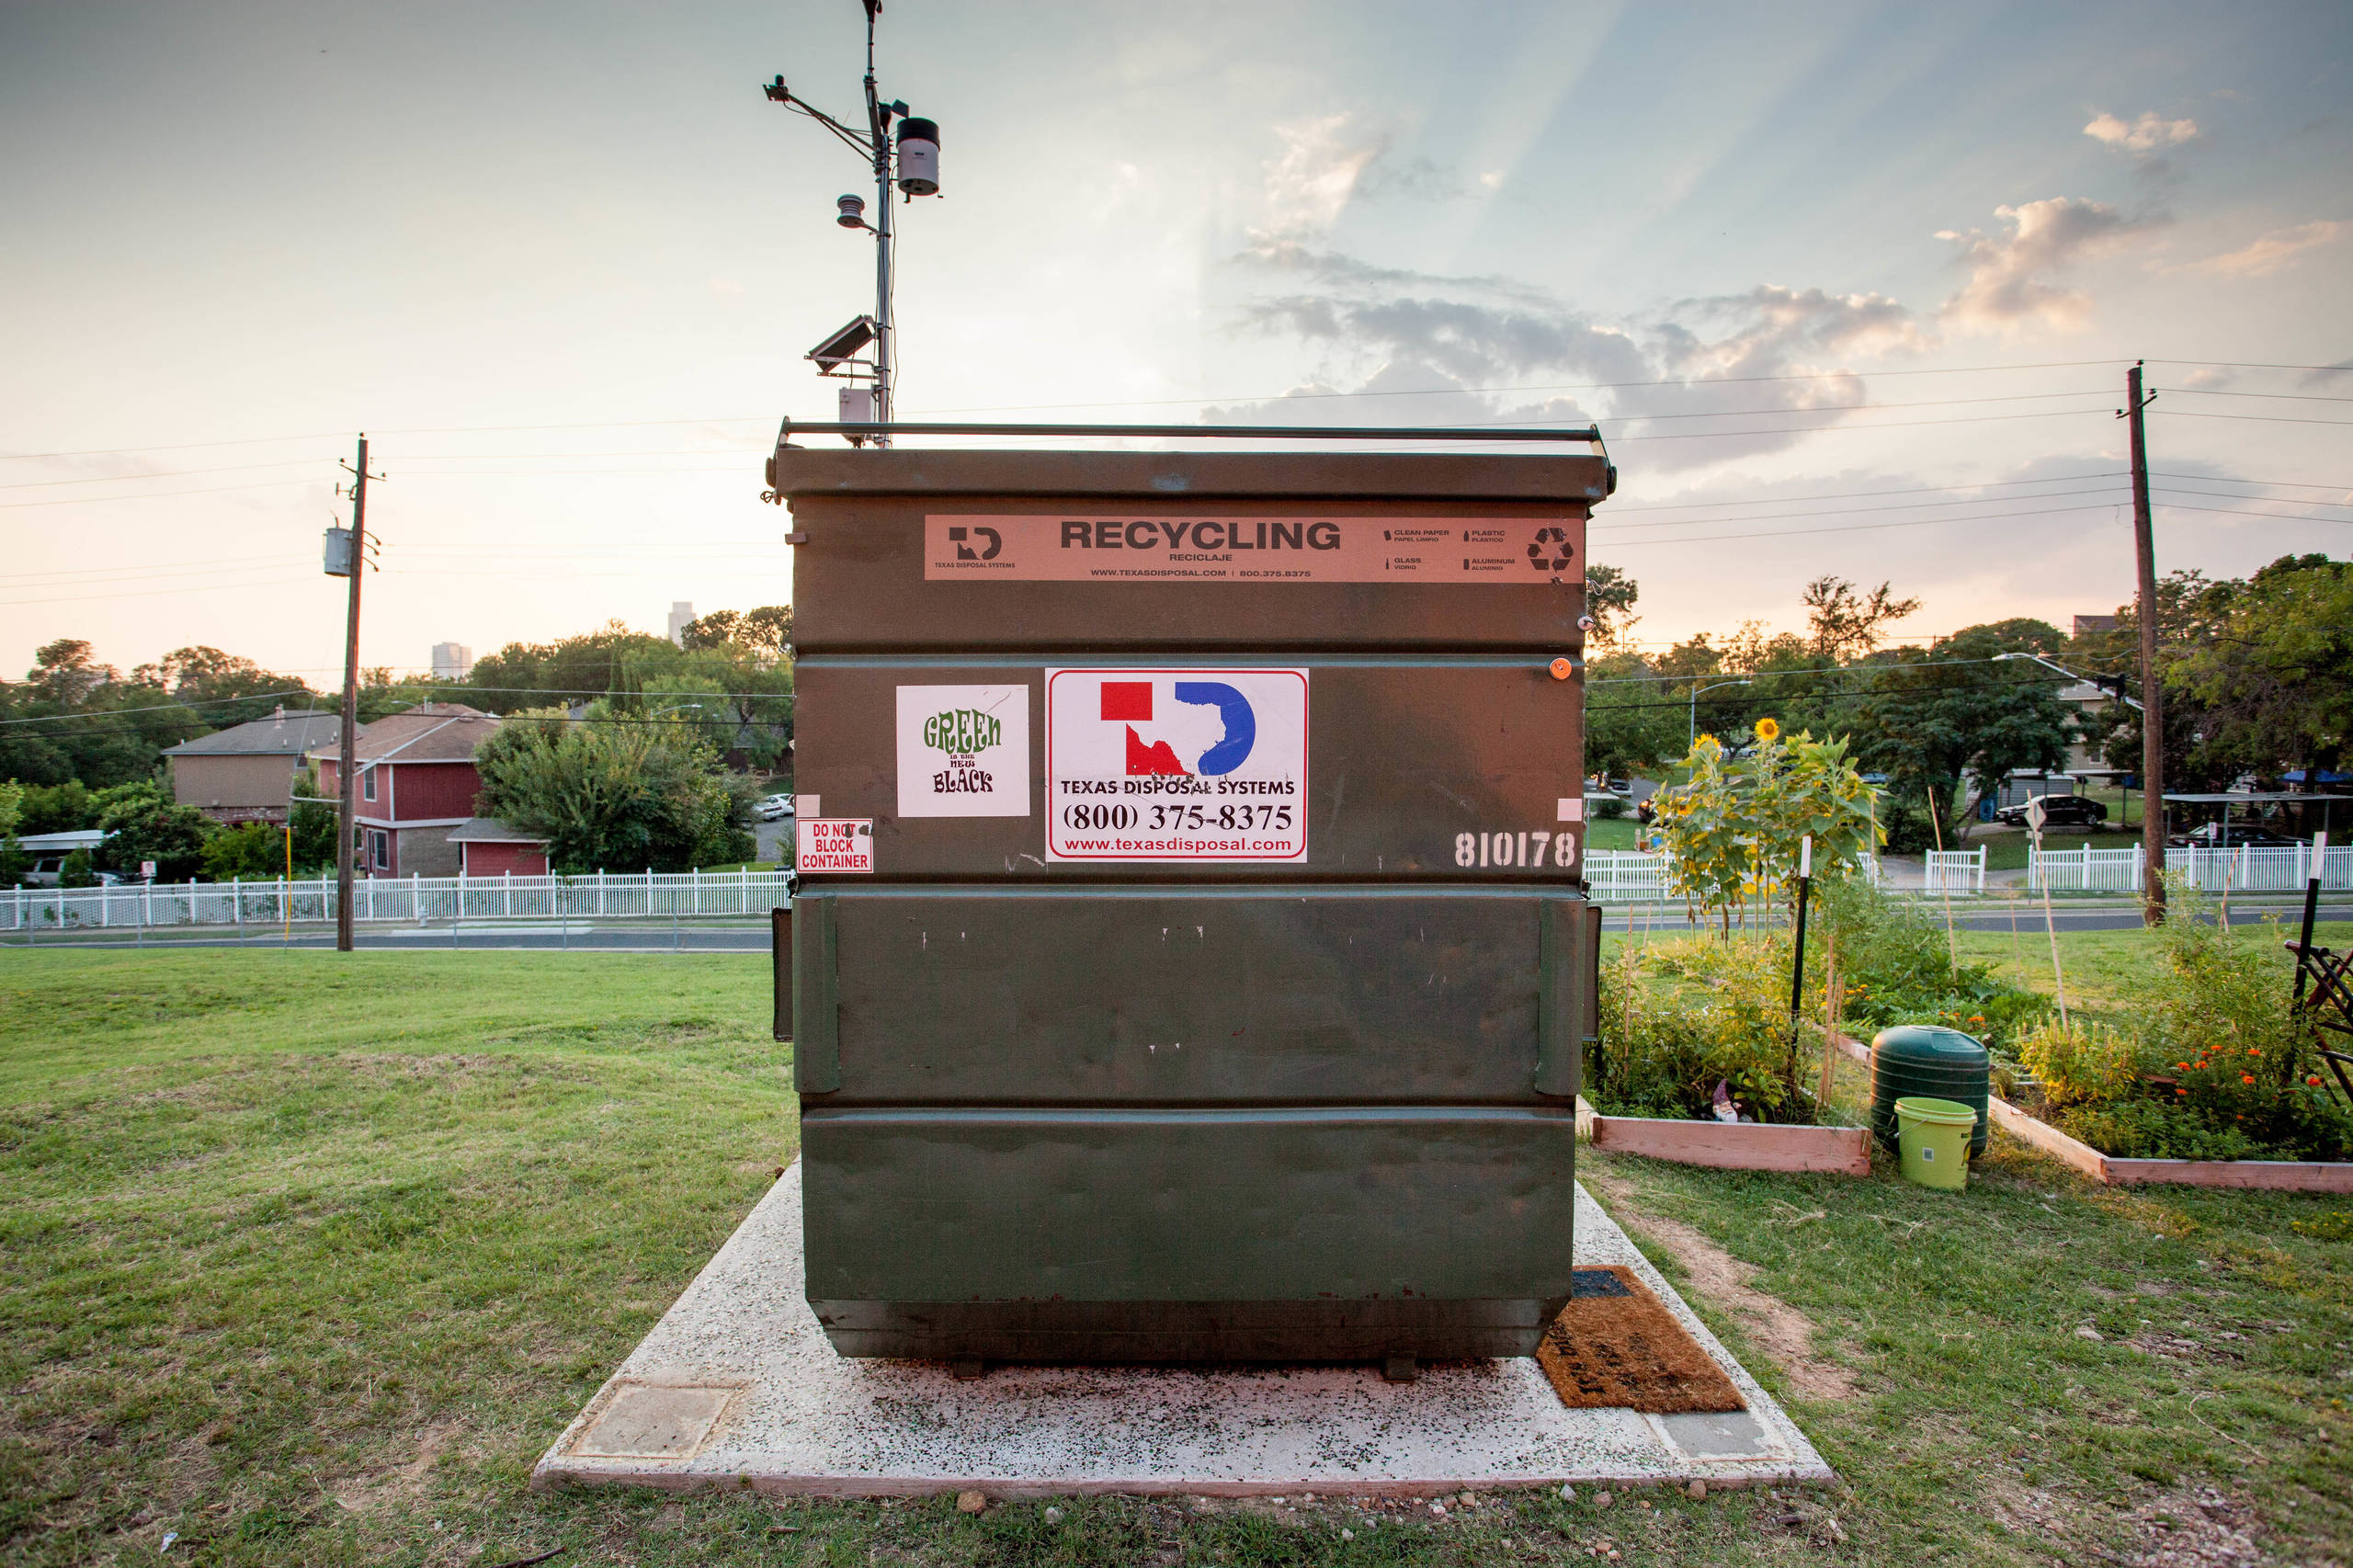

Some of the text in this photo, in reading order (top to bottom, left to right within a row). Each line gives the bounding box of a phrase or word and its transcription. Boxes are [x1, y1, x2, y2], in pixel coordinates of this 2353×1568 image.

[1061, 521, 1341, 551] RECYCLING
[1169, 553, 1233, 562] RECICLAJE
[924, 708, 1002, 755] GREEN
[933, 768, 994, 793] BLACK
[1061, 780, 1295, 795] TEXAS DISPOSAL SYSTEMS
[1063, 804, 1292, 830] (800) 375-8375
[813, 824, 829, 836] DO
[815, 839, 854, 852] BLOCK
[1064, 837, 1291, 854] www.texasdisposal.com
[1455, 832, 1575, 868] 810178
[801, 855, 869, 868] CONTAINER
